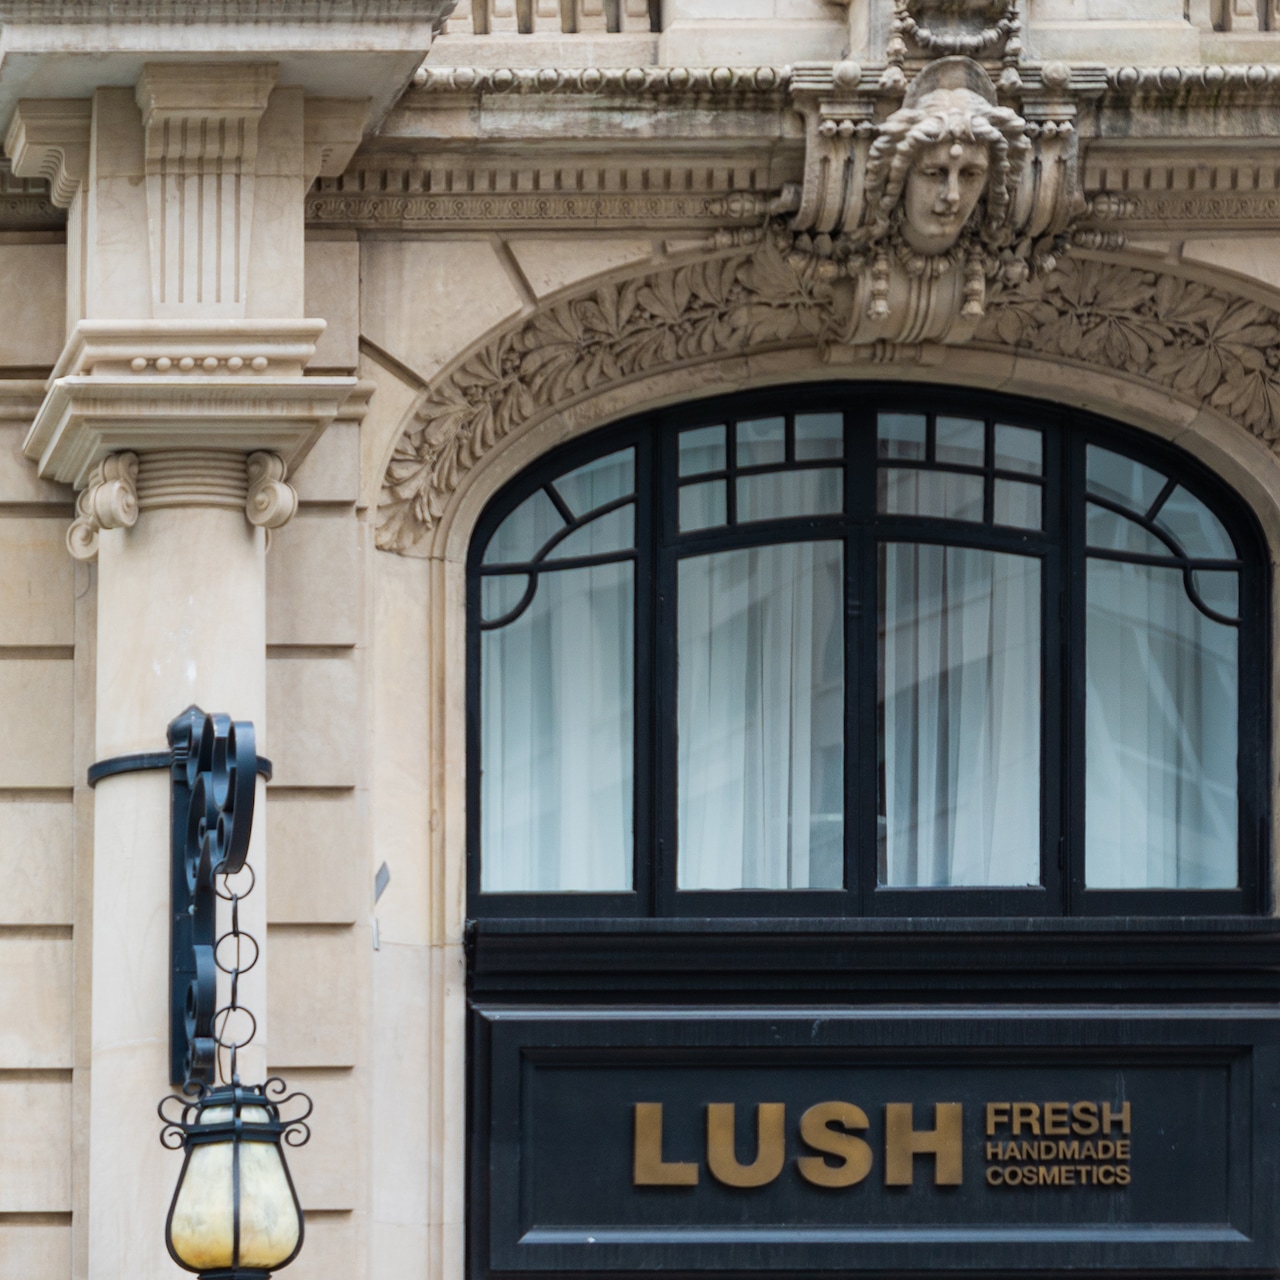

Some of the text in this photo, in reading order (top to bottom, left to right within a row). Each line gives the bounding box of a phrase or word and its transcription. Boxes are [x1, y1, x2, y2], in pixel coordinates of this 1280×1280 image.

[986, 1101, 1132, 1135] FRESH
[633, 1101, 963, 1187] LUSH
[986, 1140, 1132, 1160] HANDMADE
[986, 1164, 1132, 1186] COSMETICS
